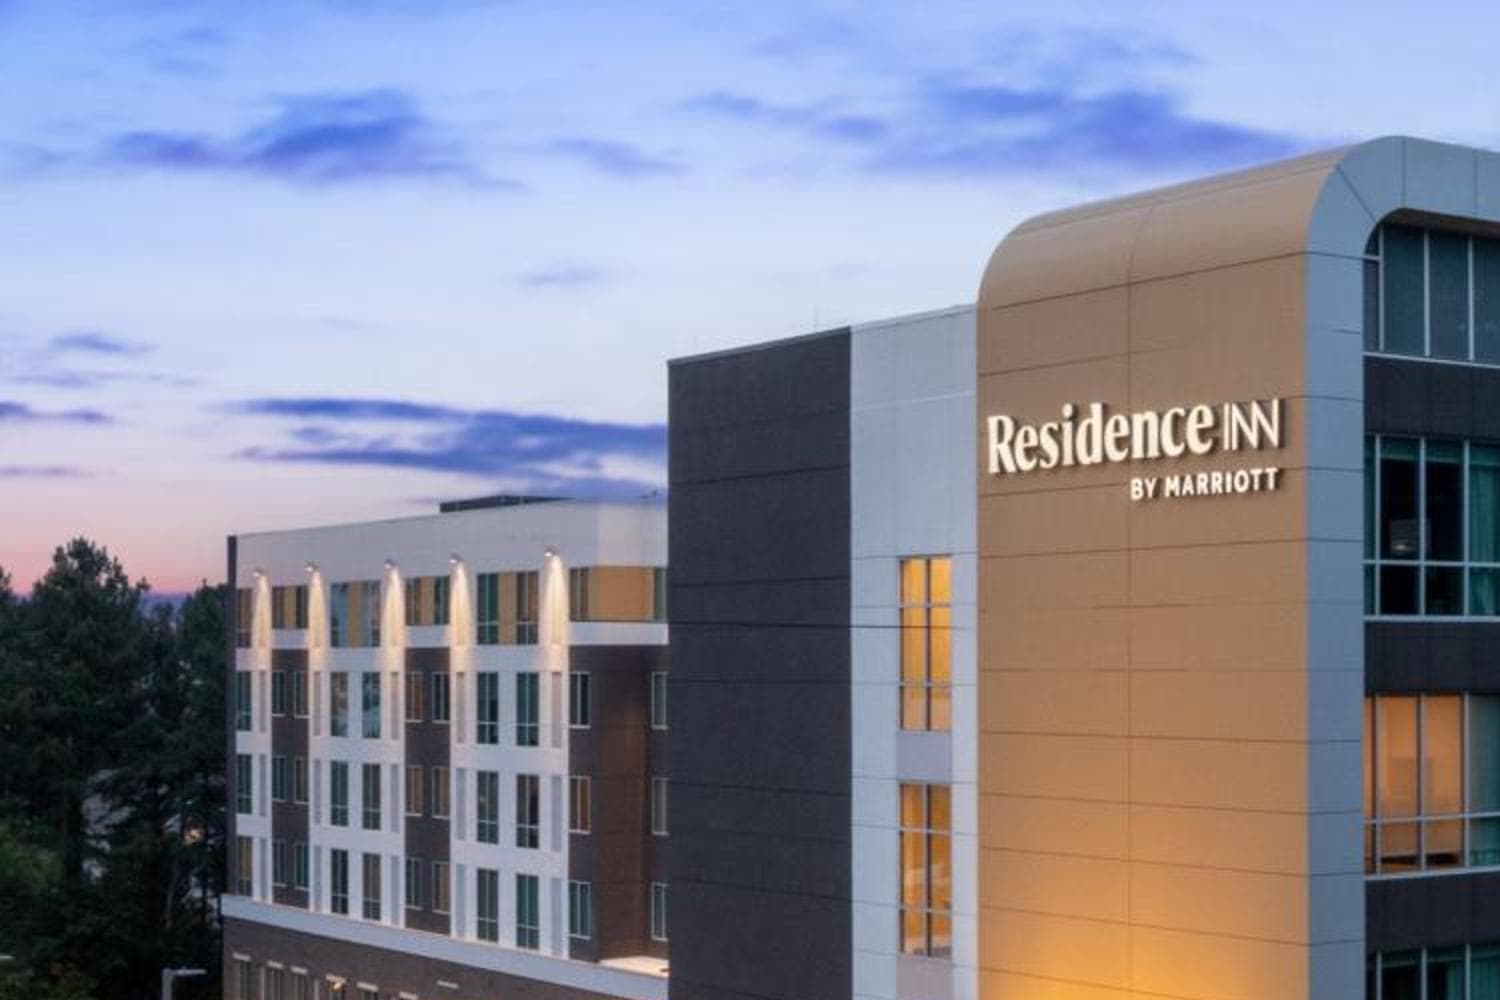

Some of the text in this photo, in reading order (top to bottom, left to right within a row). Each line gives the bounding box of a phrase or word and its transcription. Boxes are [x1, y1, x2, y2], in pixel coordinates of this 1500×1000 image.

[987, 397, 1280, 475] Residence INN
[1130, 467, 1279, 501] BY MARRIOTT
